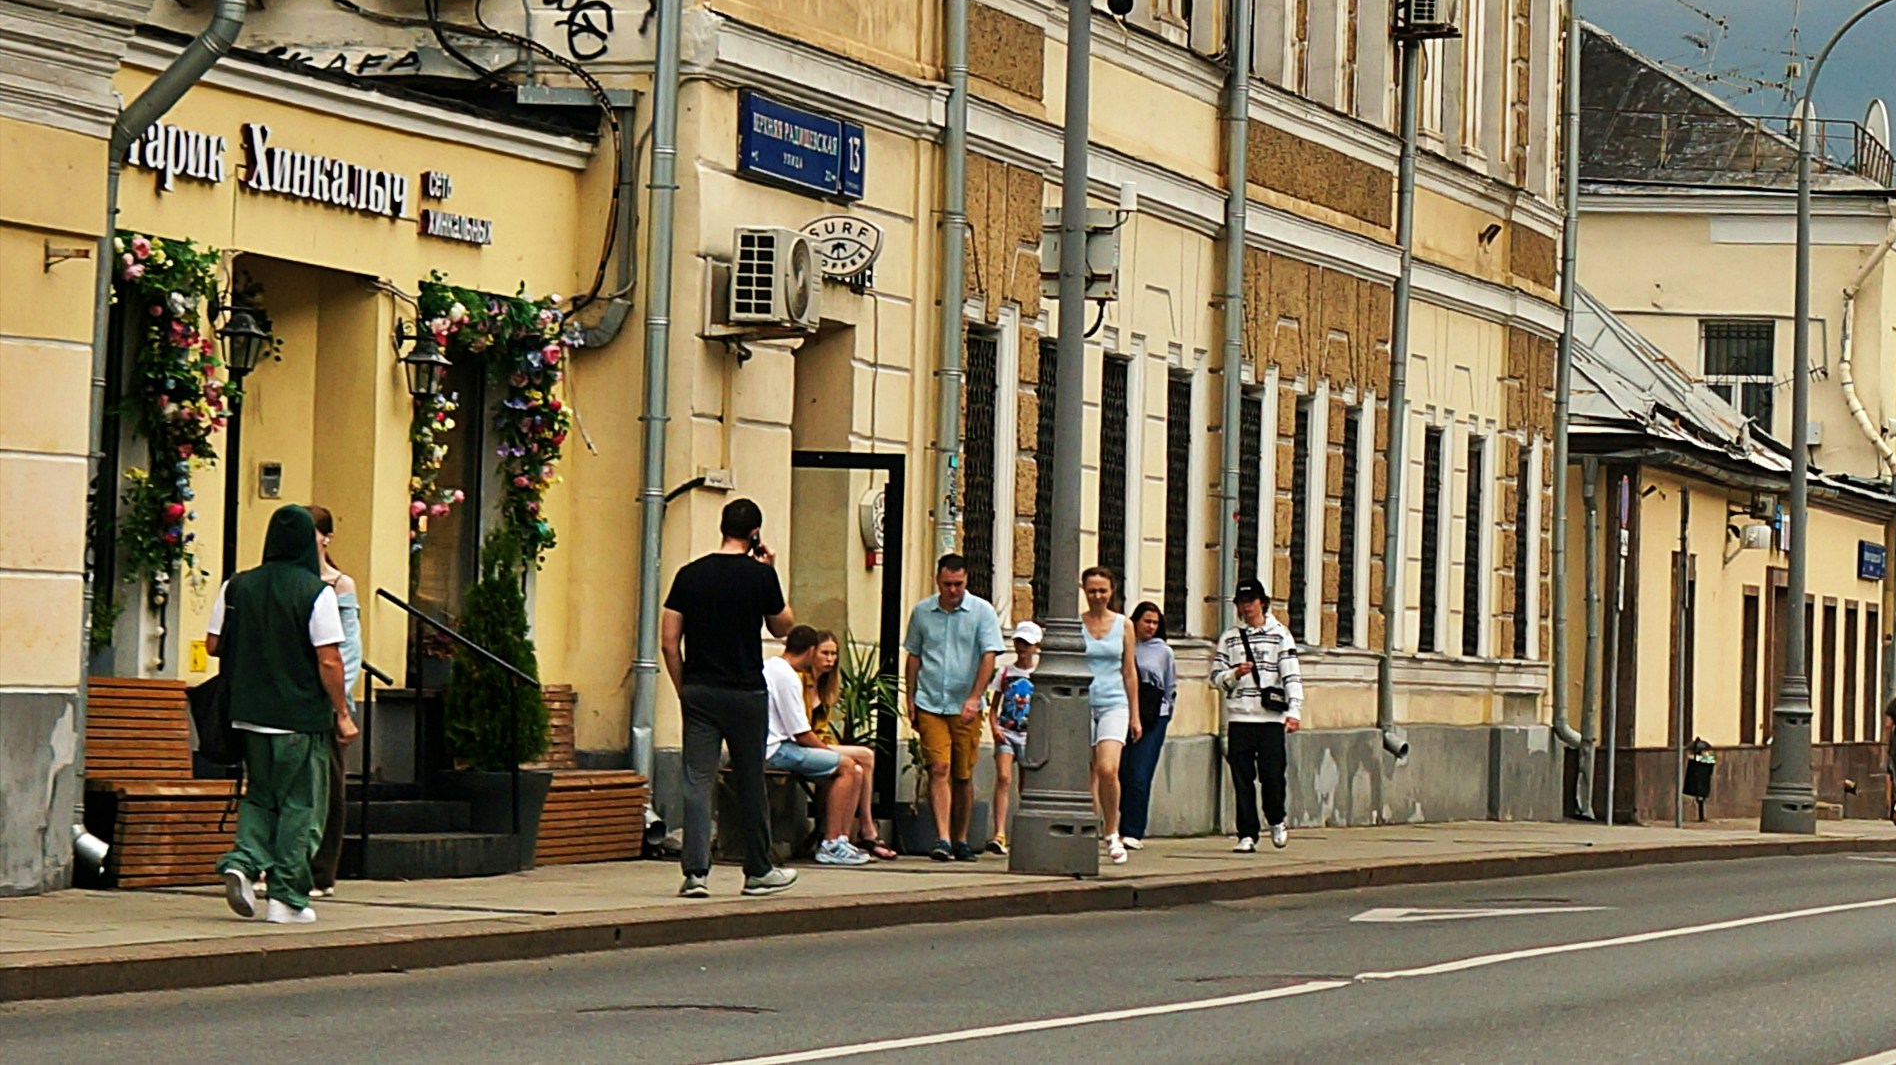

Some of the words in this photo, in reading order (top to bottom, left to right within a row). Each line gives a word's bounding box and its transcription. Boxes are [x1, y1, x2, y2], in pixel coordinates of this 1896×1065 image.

[849, 136, 861, 173] 13
[246, 122, 411, 220] Хинкалыч
[809, 221, 870, 238] SURF
[821, 251, 866, 270] OFFEE
